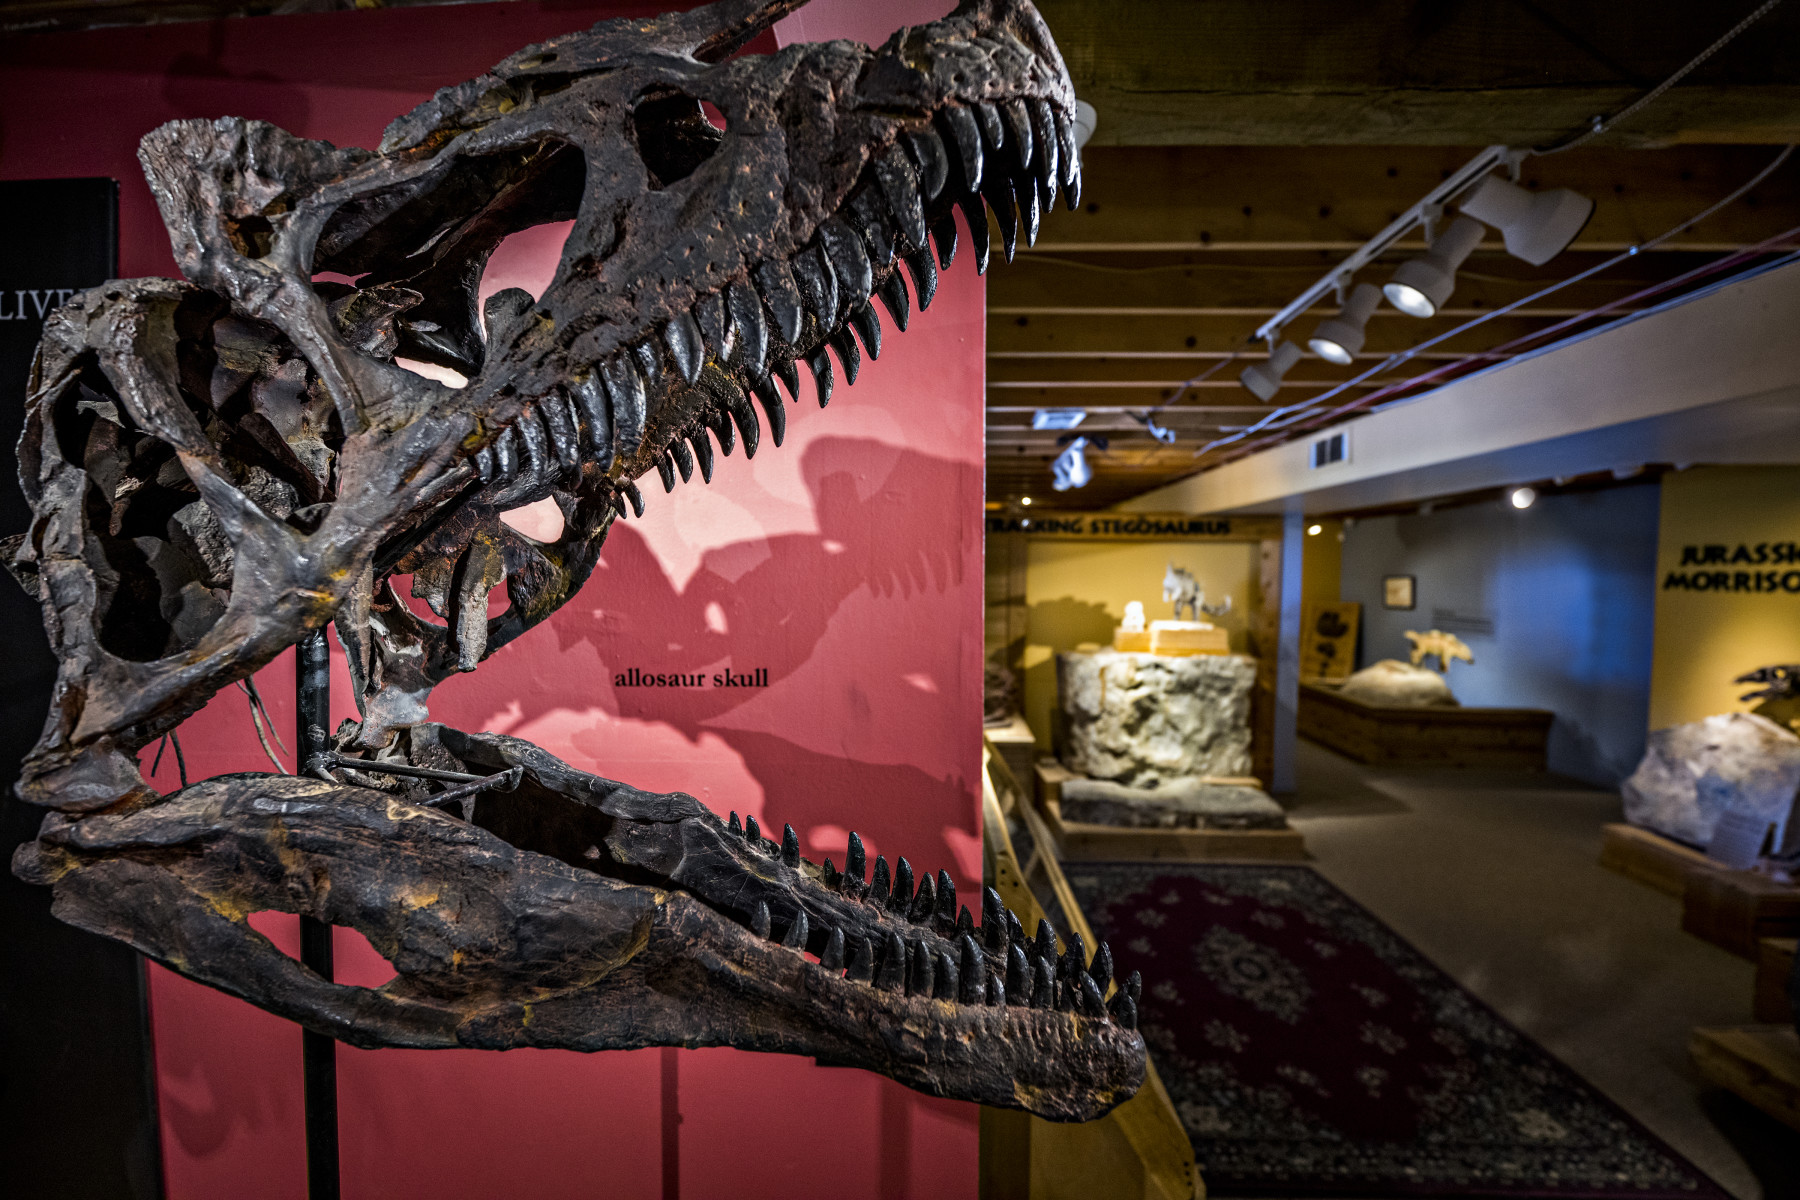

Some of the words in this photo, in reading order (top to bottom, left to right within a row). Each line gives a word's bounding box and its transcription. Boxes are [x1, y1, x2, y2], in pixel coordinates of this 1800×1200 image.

[0, 289, 92, 320] LIVE
[1090, 517, 1232, 534] STEGOSAURUS
[1680, 543, 1800, 566] JURASSI
[614, 668, 706, 687] allosaur
[713, 668, 769, 687] skull
